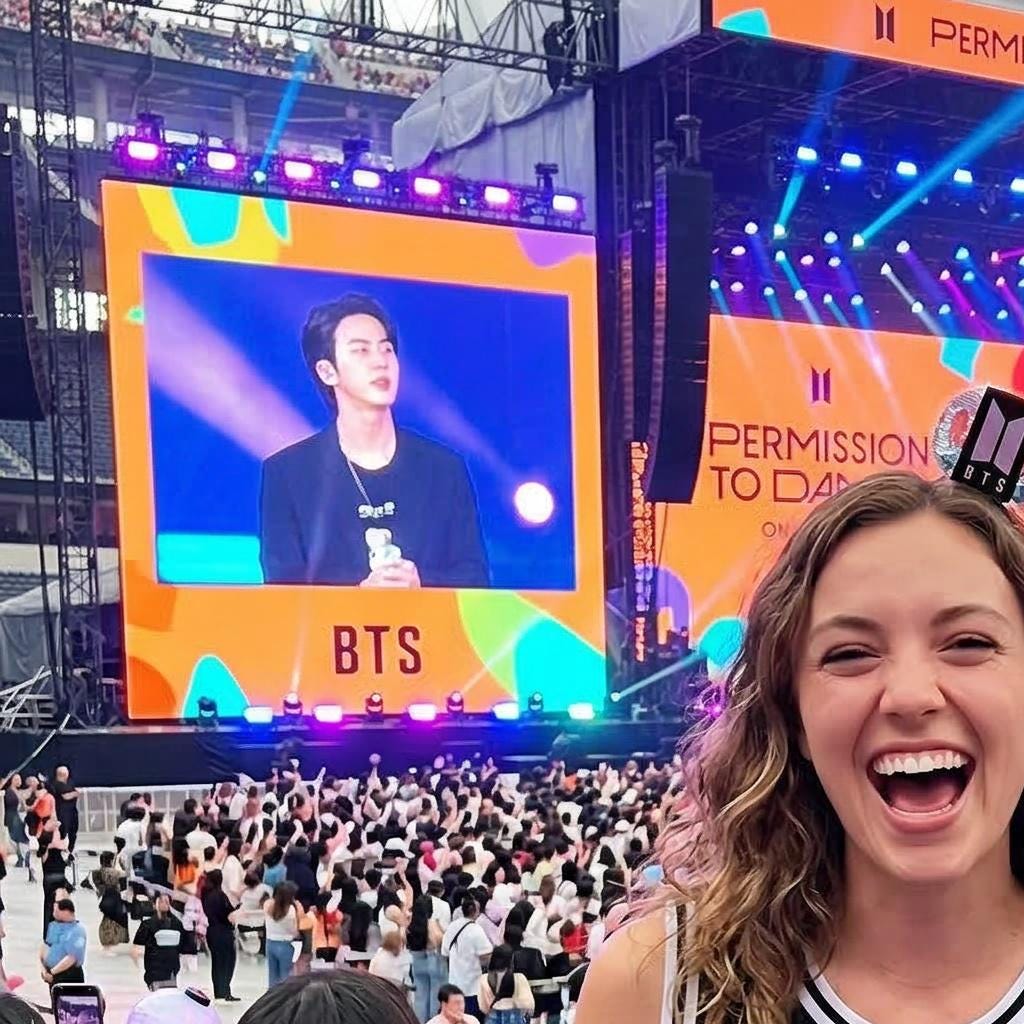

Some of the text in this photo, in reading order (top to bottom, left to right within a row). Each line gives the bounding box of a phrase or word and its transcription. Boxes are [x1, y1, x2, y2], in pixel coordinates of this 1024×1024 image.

[708, 421, 929, 468] PERMISSION
[709, 465, 761, 502] TO
[963, 464, 1006, 493] BTS
[333, 624, 422, 675] BTS
